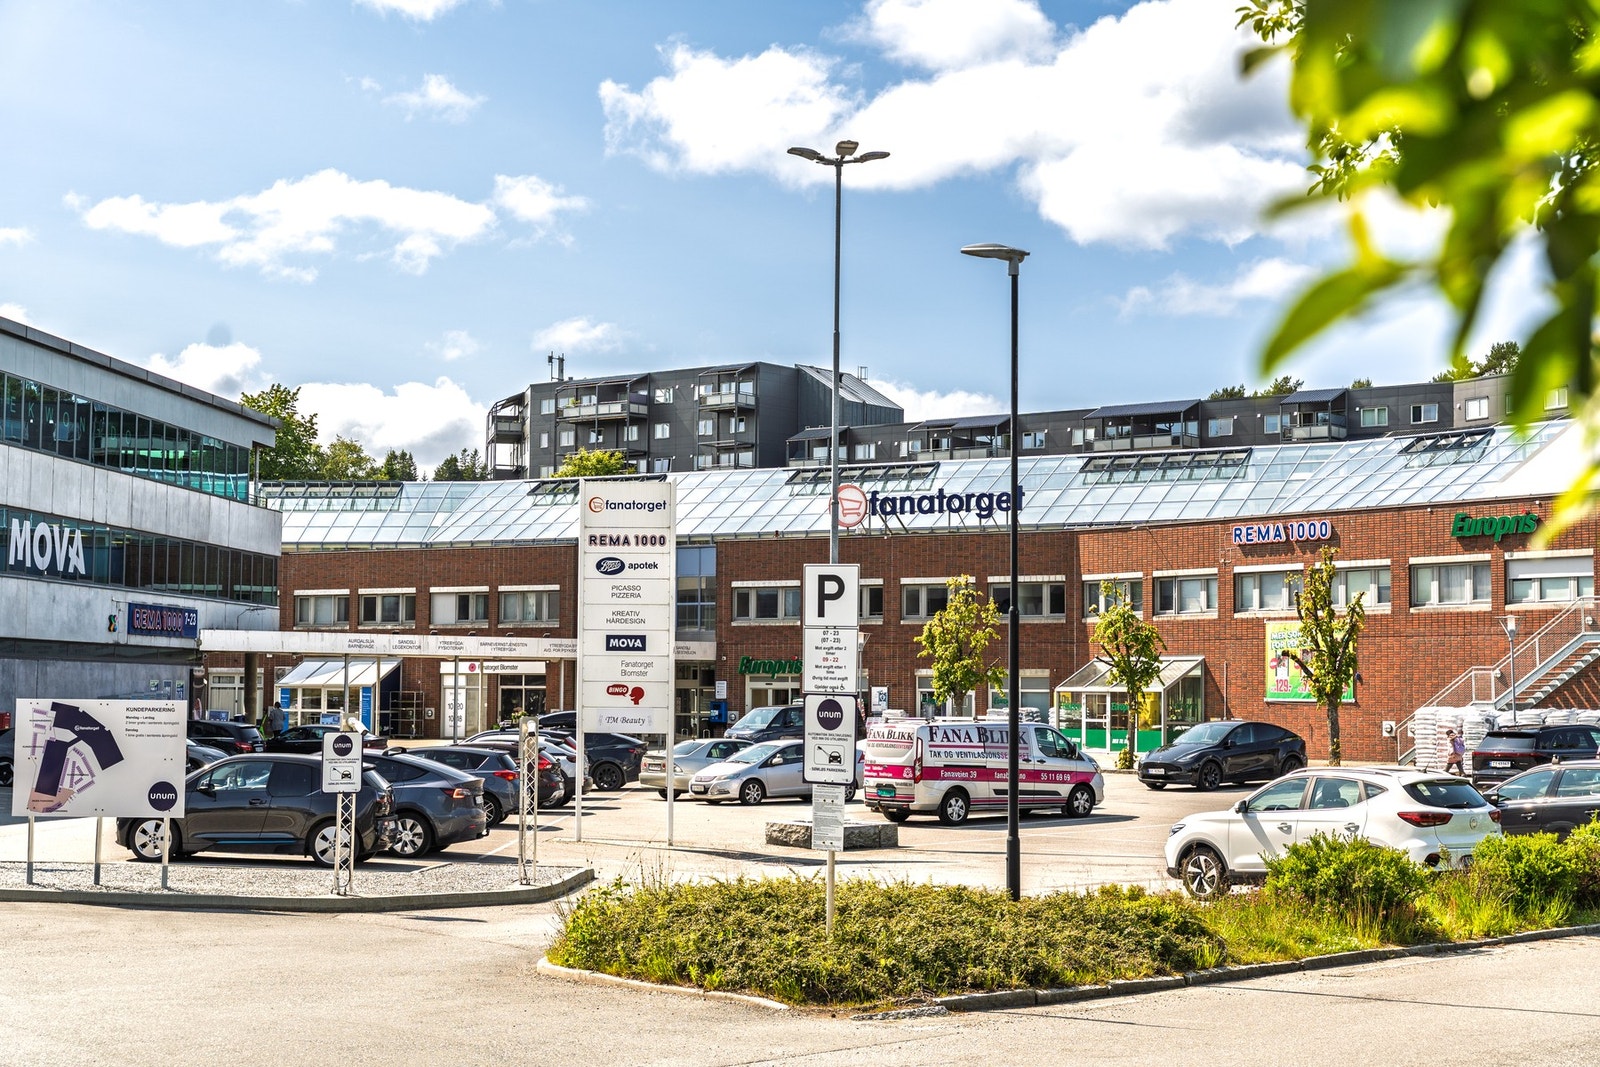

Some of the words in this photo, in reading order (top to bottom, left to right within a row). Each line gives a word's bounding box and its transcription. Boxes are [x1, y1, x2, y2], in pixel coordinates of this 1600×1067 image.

[606, 500, 666, 512] fanatorget
[870, 485, 1025, 519] fanatorget
[1233, 524, 1285, 544] REMA
[1289, 520, 1331, 540] 1000
[1451, 510, 1538, 542] Europris
[8, 518, 86, 575] MOVA
[588, 535, 630, 546] REMA
[634, 535, 666, 546] 1000
[628, 561, 658, 570] apotek
[818, 574, 846, 618] P
[133, 608, 162, 630] REMA
[162, 610, 184, 632] 1000
[184, 612, 196, 626] 7-23
[609, 638, 642, 648] MOVA
[621, 660, 654, 669] Fanatorget
[738, 656, 803, 679] Europris
[621, 716, 646, 726] Beauty
[868, 729, 885, 739] FANA
[886, 728, 914, 740] BLIKK
[927, 726, 973, 743] FANA
[929, 750, 941, 758] TAK
[940, 770, 968, 778] Fanaveien
